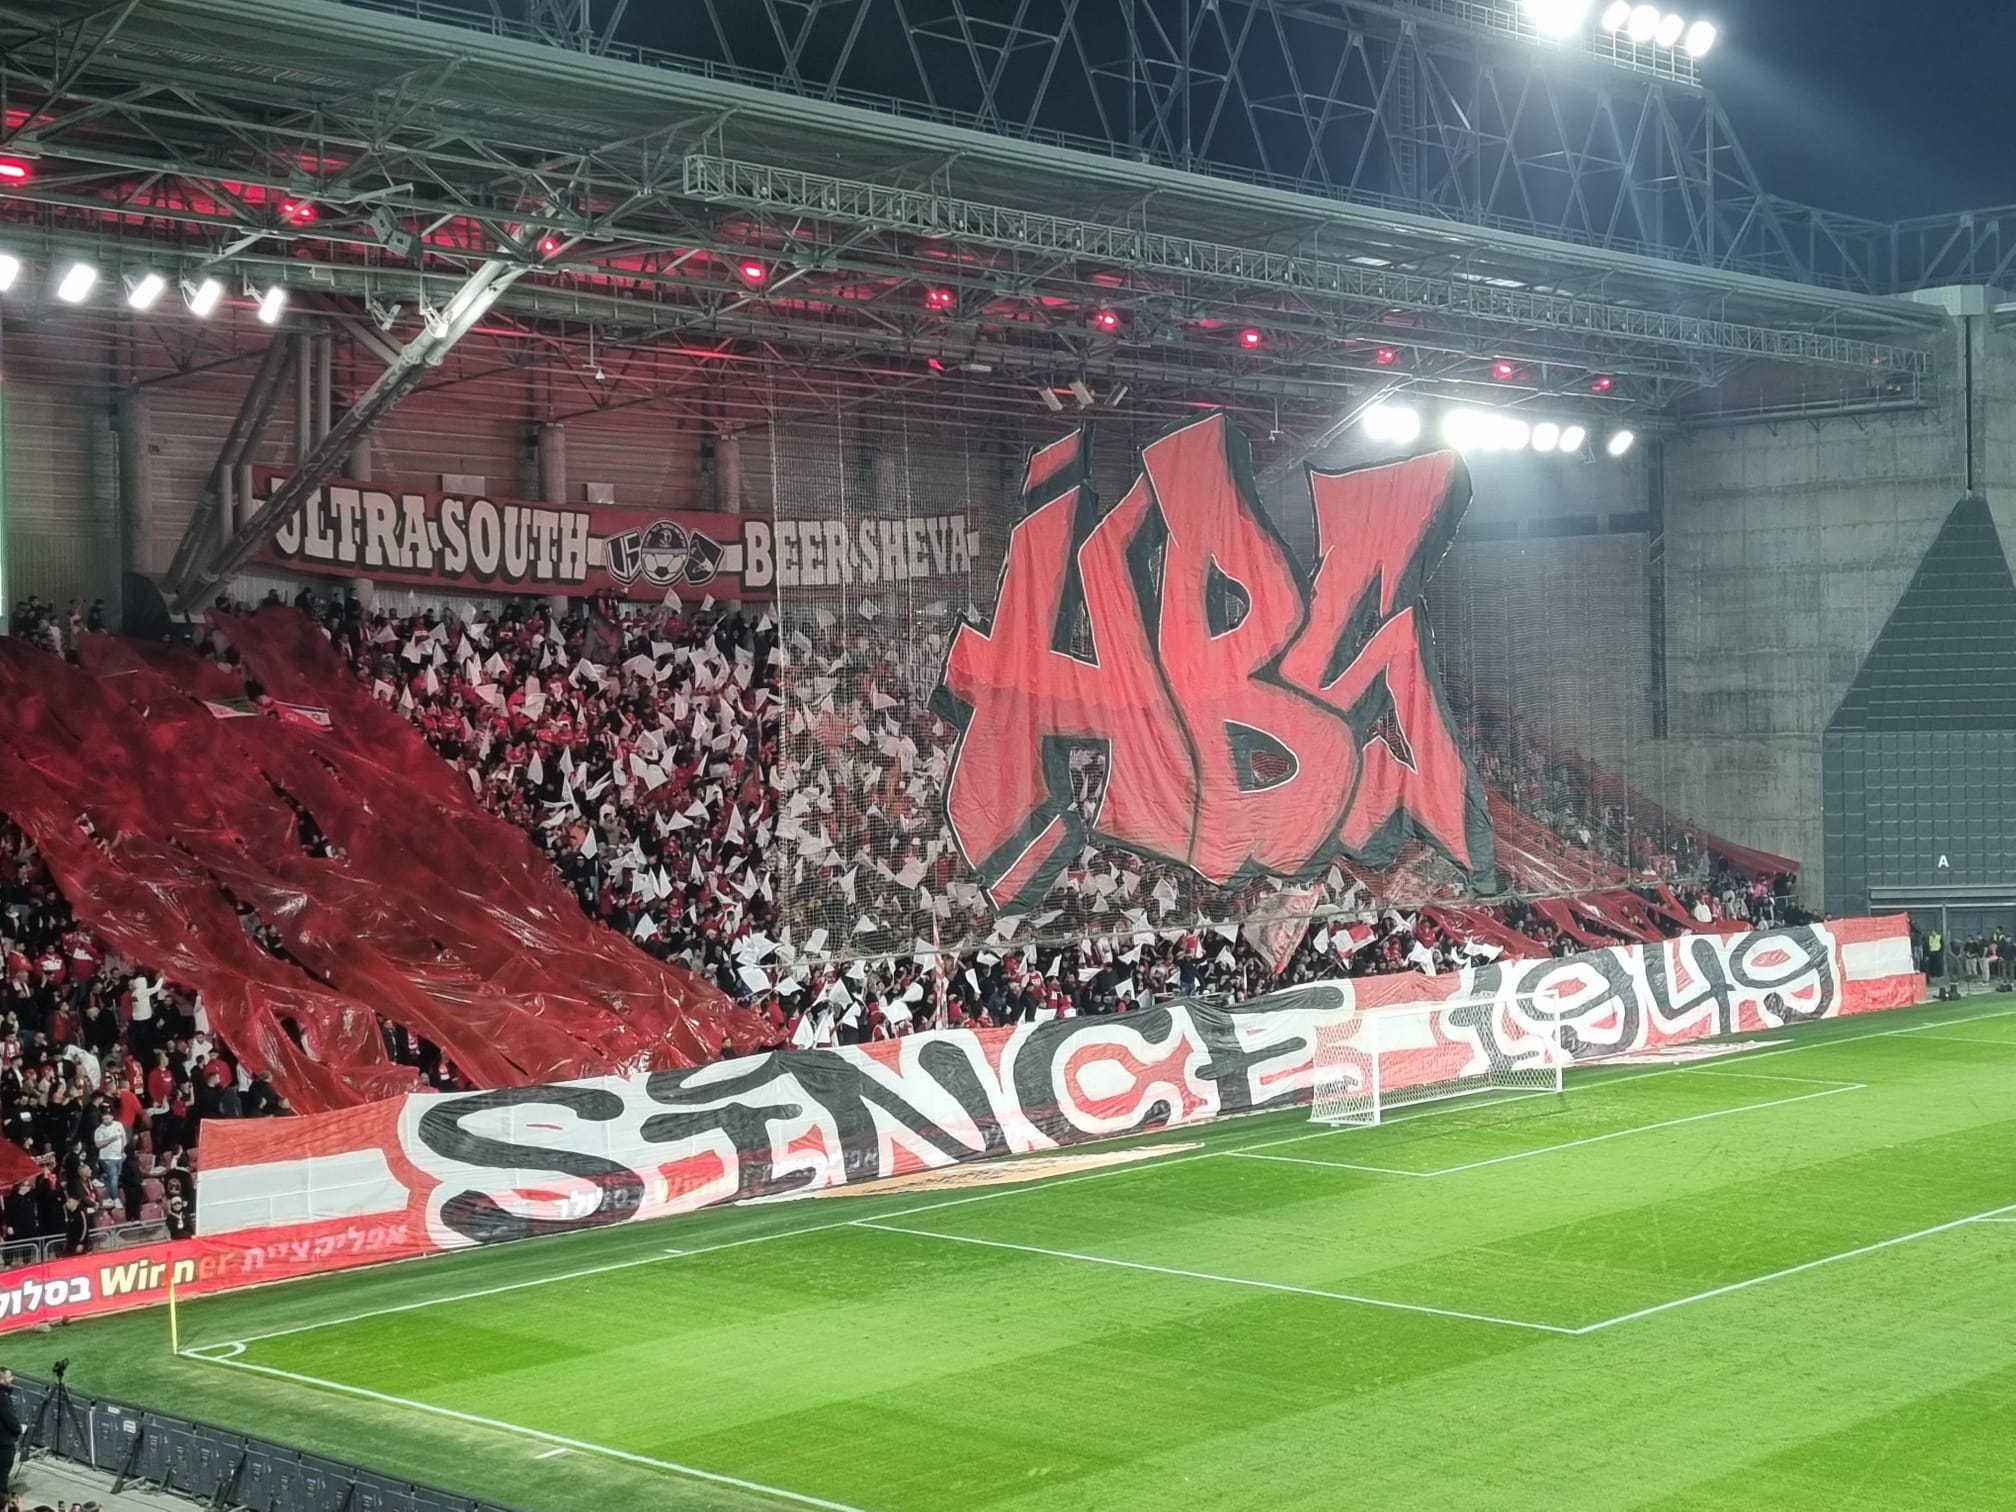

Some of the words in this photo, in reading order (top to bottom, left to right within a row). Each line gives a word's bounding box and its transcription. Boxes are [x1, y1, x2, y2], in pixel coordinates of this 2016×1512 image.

[441, 498, 590, 580] SOUTH
[744, 520, 853, 587] BEER
[859, 515, 969, 584] SHEVA
[1937, 854, 1949, 868] A
